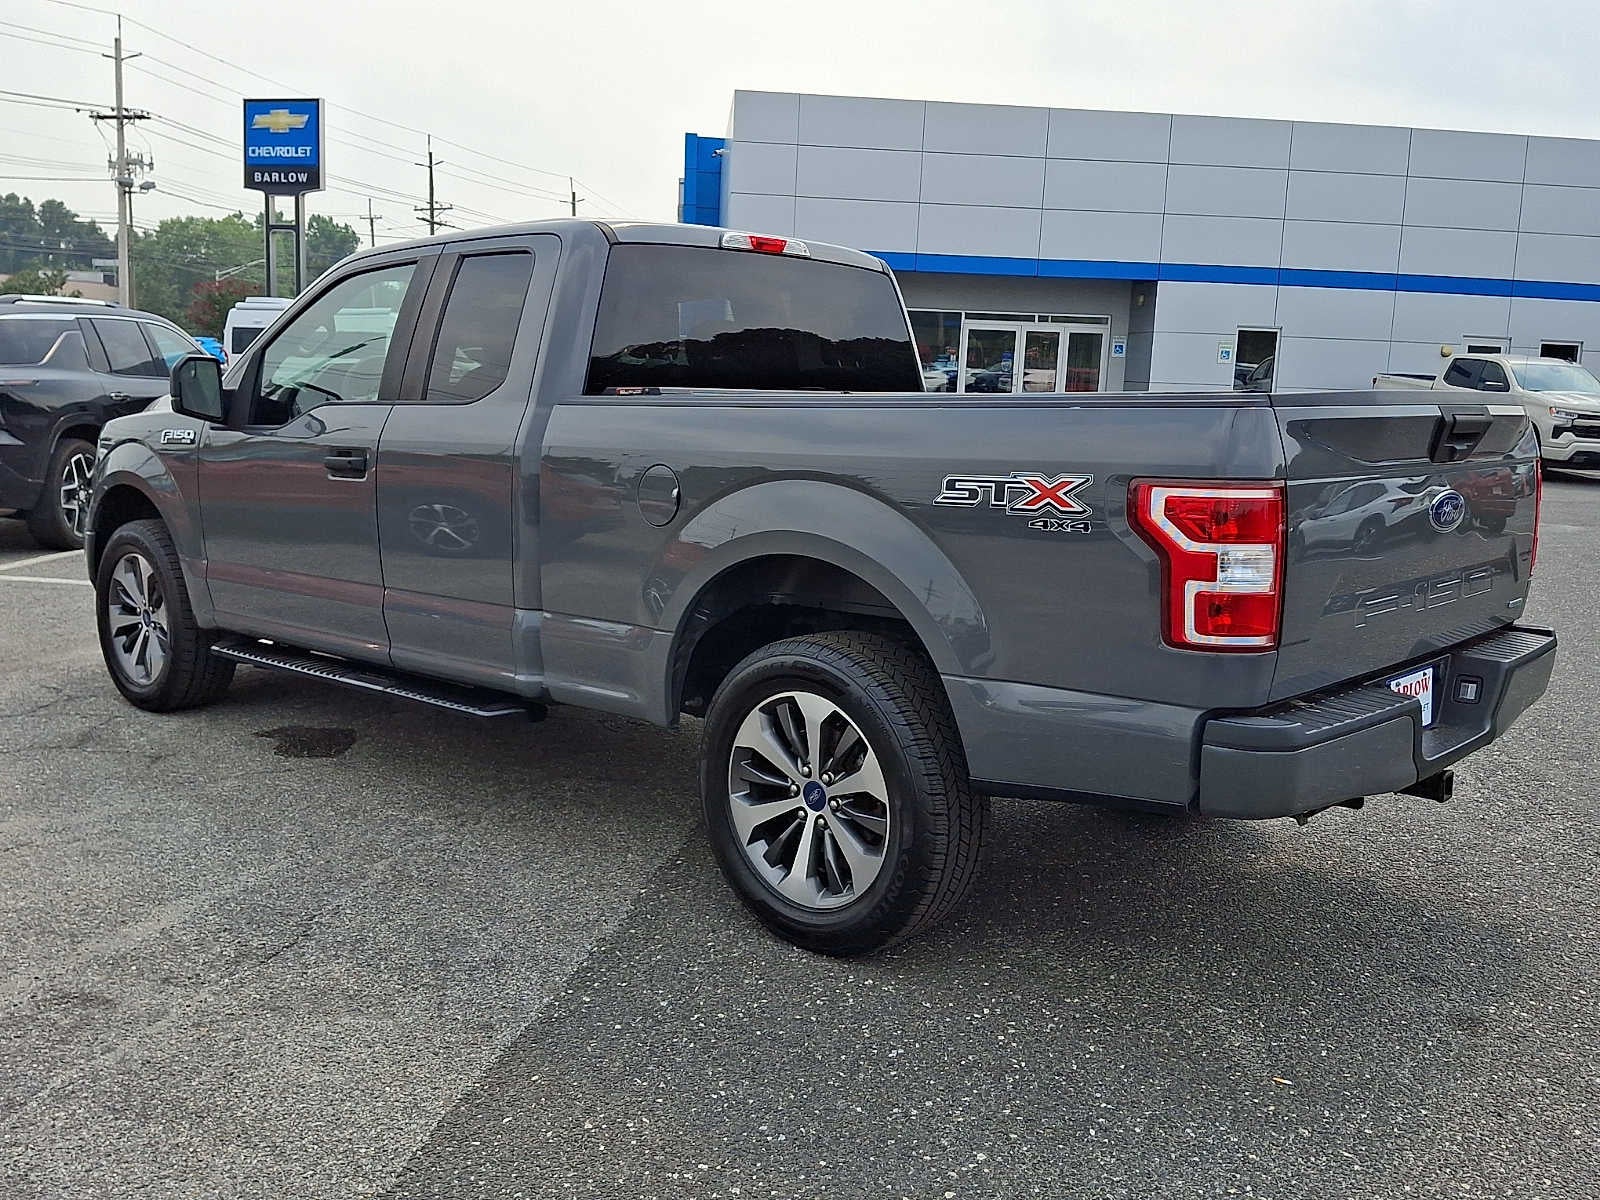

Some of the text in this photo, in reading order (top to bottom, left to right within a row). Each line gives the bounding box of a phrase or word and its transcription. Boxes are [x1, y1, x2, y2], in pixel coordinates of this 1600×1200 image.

[248, 146, 312, 157] CHEVROLET
[254, 172, 308, 183] BARLOW
[933, 472, 1094, 518] STX
